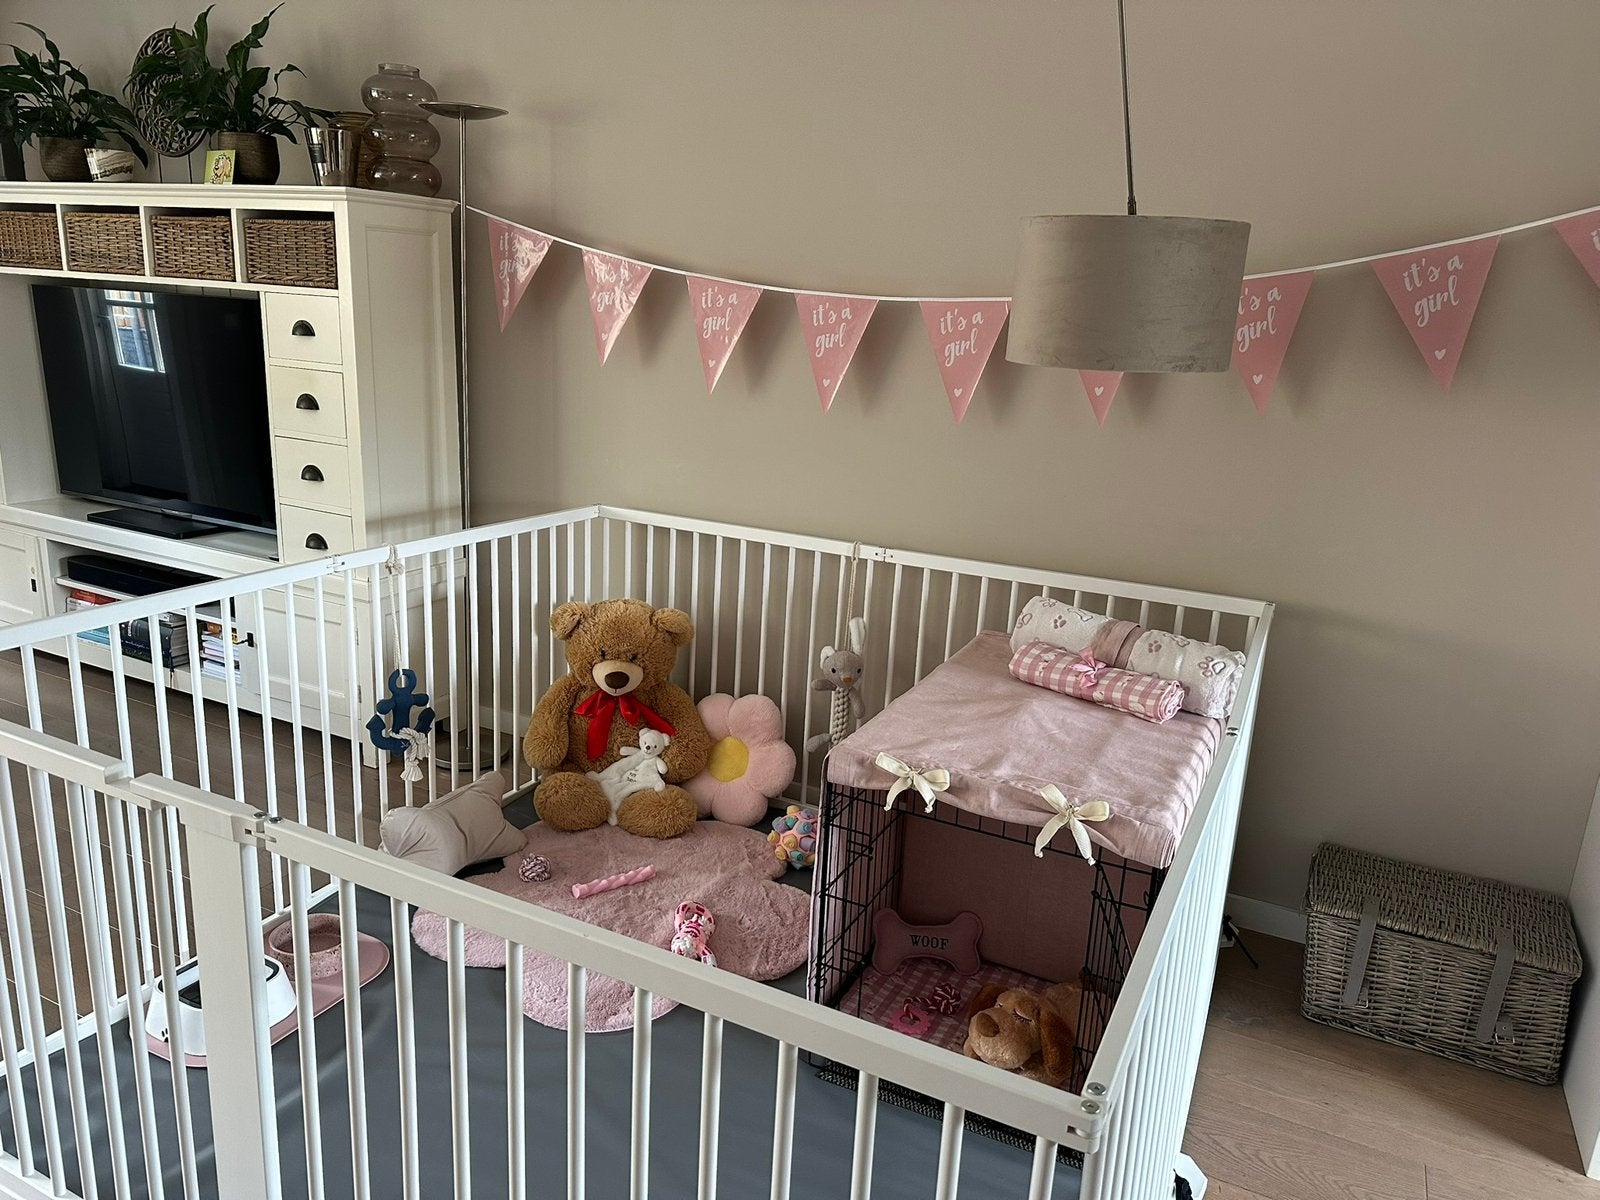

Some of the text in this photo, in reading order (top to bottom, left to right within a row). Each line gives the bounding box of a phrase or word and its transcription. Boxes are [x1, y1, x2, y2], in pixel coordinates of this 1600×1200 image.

[1403, 254, 1464, 292] it's a
[702, 286, 738, 308] it's a
[1238, 287, 1282, 315] t's a
[1414, 275, 1460, 328] girl
[702, 307, 732, 339] girl
[812, 302, 852, 327] it's a
[939, 308, 984, 335] it's a
[1236, 305, 1277, 352] girl
[815, 323, 846, 358] girl
[944, 328, 978, 367] girl
[909, 934, 949, 950] WOOF
